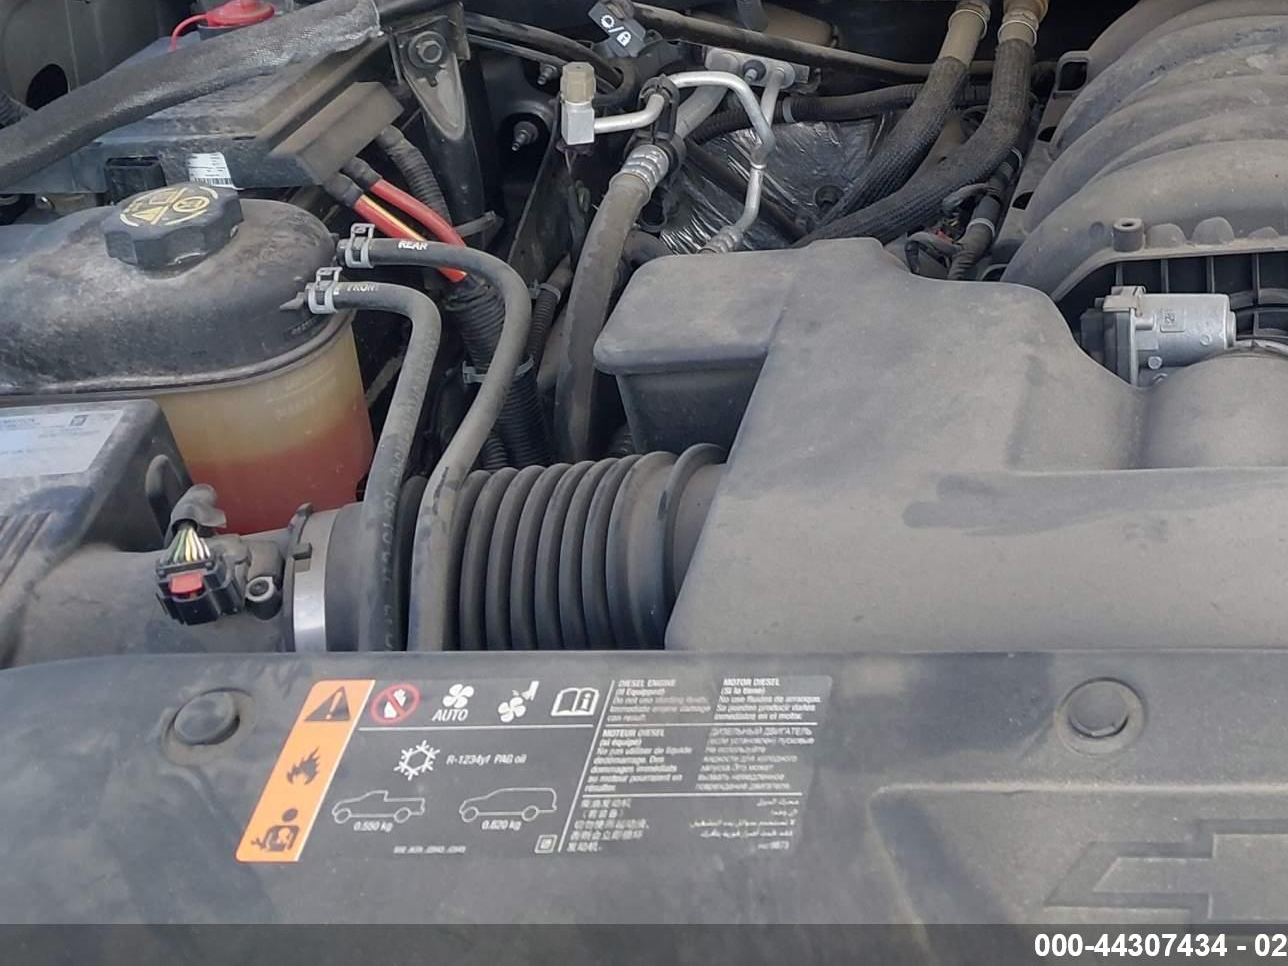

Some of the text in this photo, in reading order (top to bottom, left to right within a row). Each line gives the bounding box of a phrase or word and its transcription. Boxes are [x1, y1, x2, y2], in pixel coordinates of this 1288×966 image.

[398, 240, 428, 251] REAR
[618, 679, 645, 687] DIESEL
[723, 678, 780, 686] MOTOR DIESEL
[431, 708, 468, 722] AUTO
[602, 729, 664, 737] MOTEUR DIESEL
[446, 754, 491, 766] R-1234yf
[380, 821, 394, 833] kg
[508, 820, 522, 832] kg
